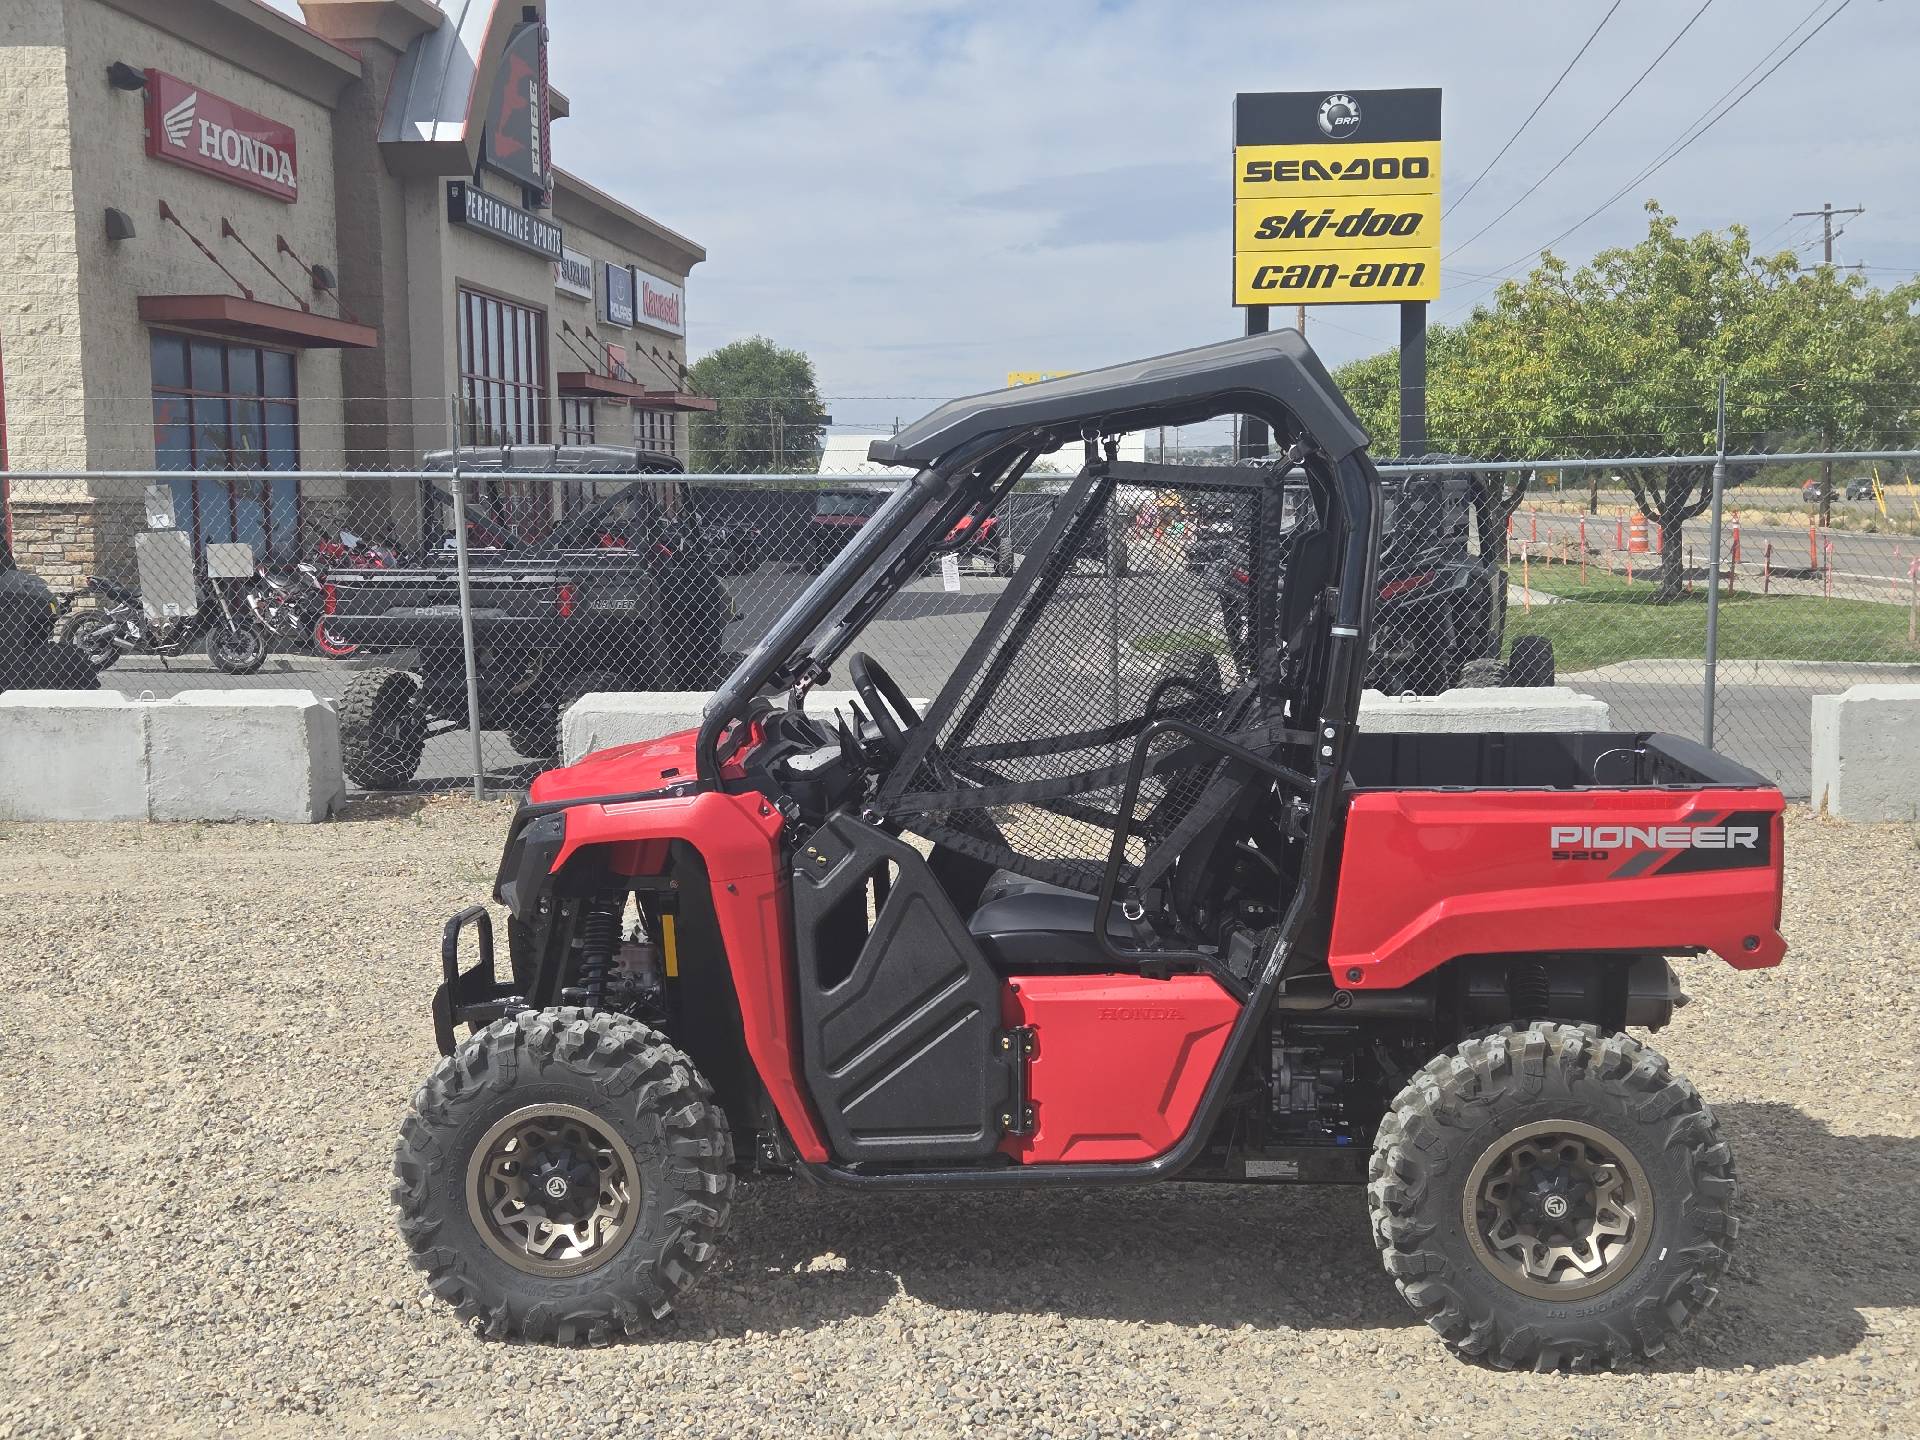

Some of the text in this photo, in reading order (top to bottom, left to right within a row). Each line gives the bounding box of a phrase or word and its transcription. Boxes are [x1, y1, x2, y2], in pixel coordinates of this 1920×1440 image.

[1335, 117, 1359, 125] BRP
[199, 118, 297, 189] HONDA
[466, 190, 561, 254] PERFORMANCE SPORTS
[1254, 208, 1424, 239] ski-doo
[561, 259, 591, 289] SUZUKI
[1251, 263, 1426, 289] can-am
[643, 281, 680, 327] Kawasaki
[415, 607, 468, 616] POLAR
[592, 599, 635, 609] RANGER
[1551, 826, 1759, 849] PIONEER
[1552, 851, 1609, 861] 520
[1097, 1007, 1185, 1020] HONDA
